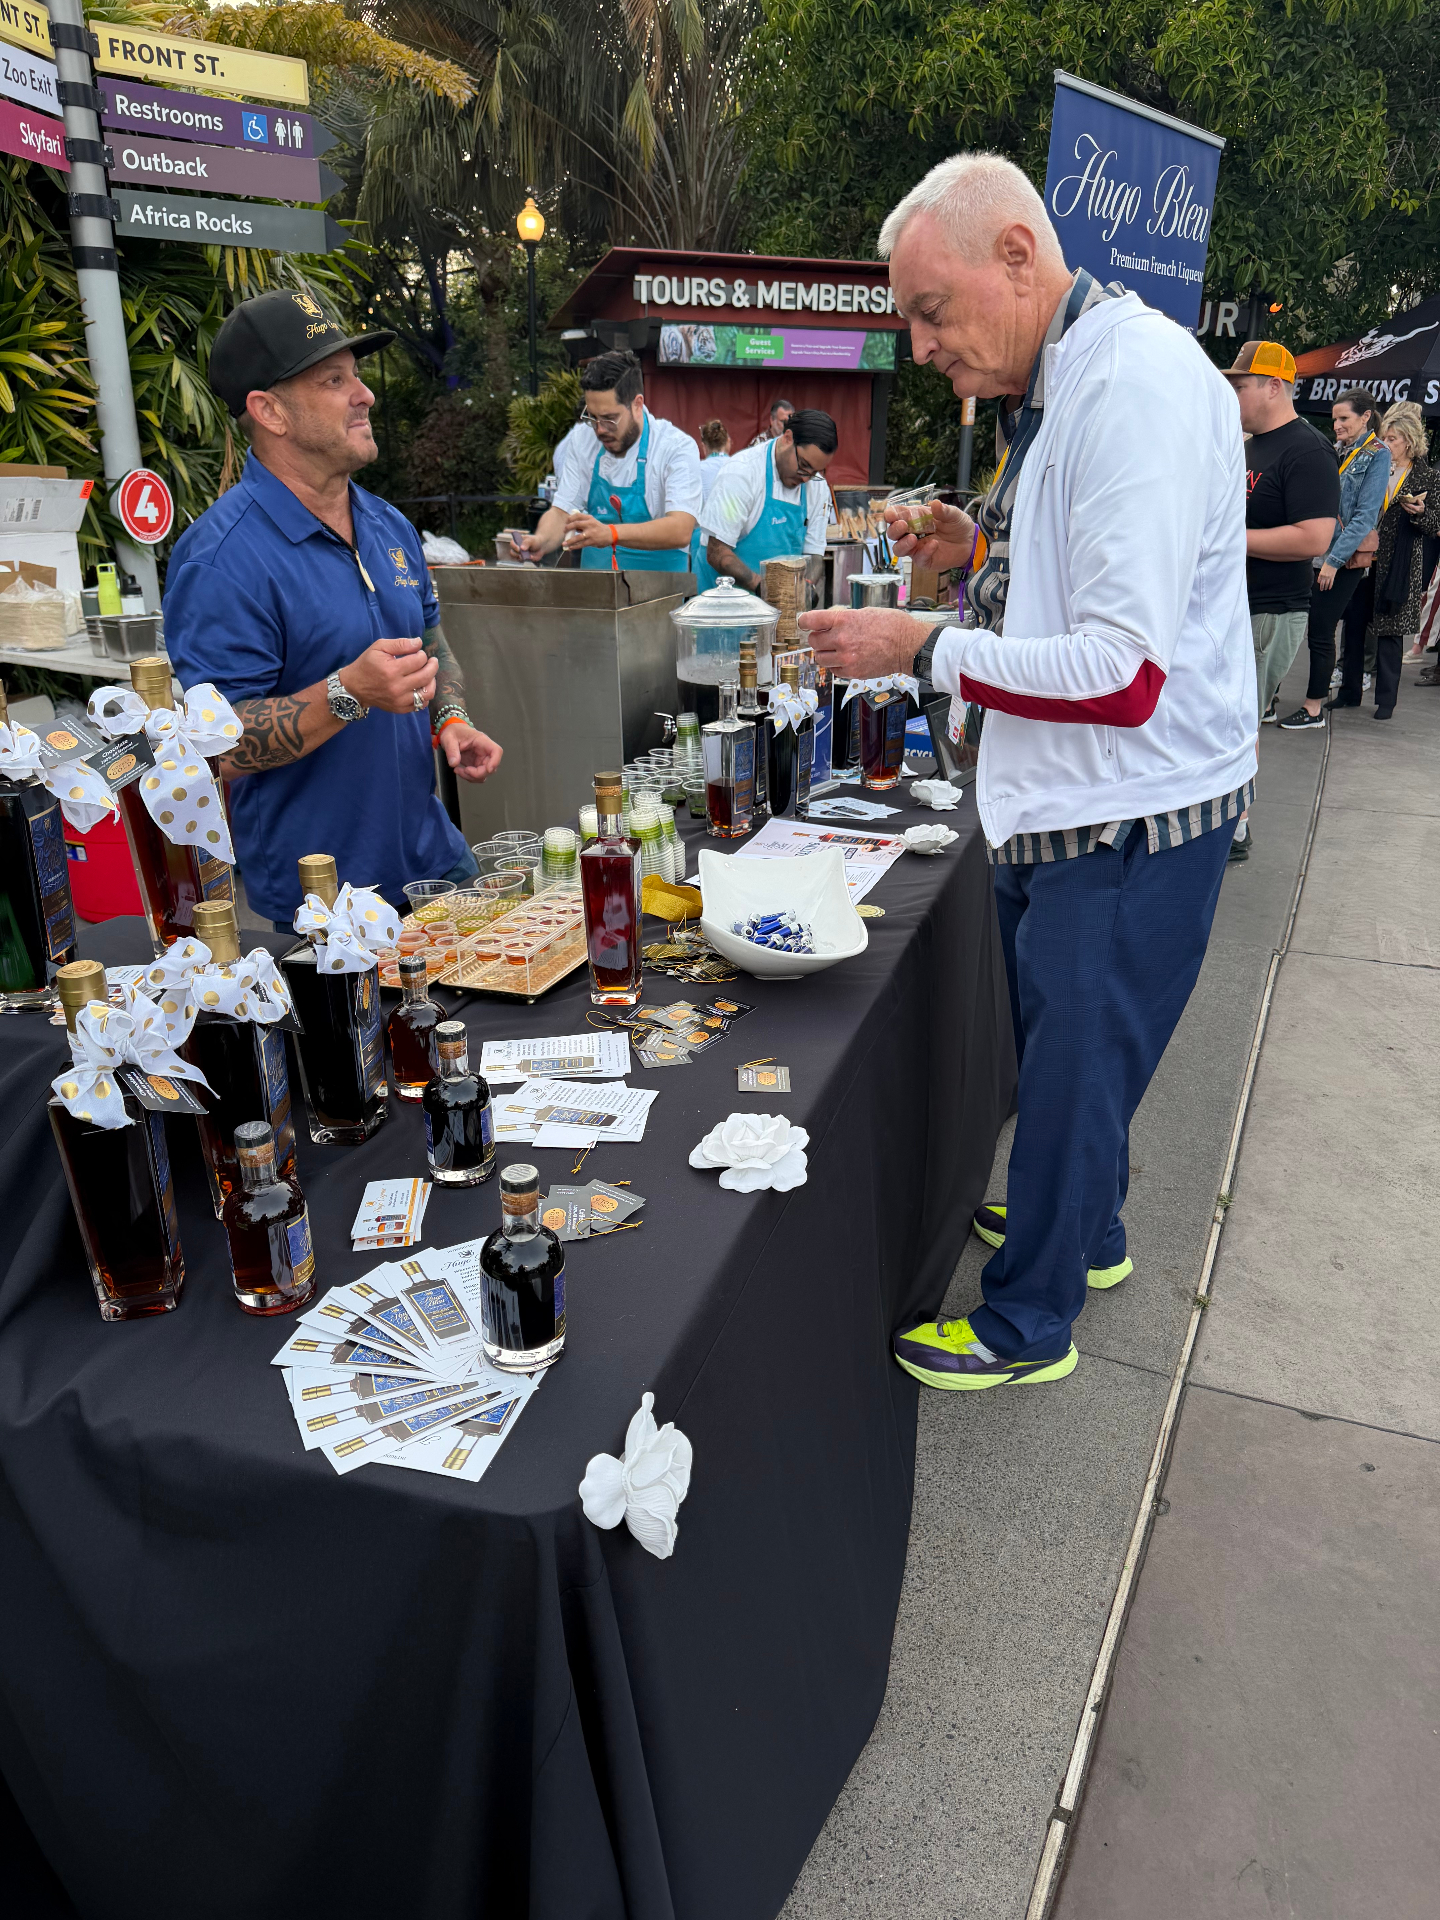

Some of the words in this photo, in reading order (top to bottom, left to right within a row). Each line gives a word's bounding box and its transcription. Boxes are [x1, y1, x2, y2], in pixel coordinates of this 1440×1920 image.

[24, 11, 45, 40] ST.
[108, 37, 187, 70] FRONT
[194, 54, 226, 78] ST.
[2, 57, 28, 82] Zoo
[30, 70, 53, 97] Exit
[115, 95, 224, 132] Restrooms
[19, 122, 62, 156] Skyfari
[122, 149, 209, 178] Outback
[1052, 133, 1142, 242] Hugo
[1146, 164, 1209, 243] Bleu
[130, 204, 191, 230] Africa
[196, 211, 253, 235] Rocks
[1110, 247, 1150, 272] Premium
[1150, 256, 1177, 278] French
[634, 274, 726, 308] TOURS
[732, 279, 750, 308] &
[745, 346, 776, 356] Services
[749, 338, 772, 346] Guest
[133, 484, 160, 524] 4
